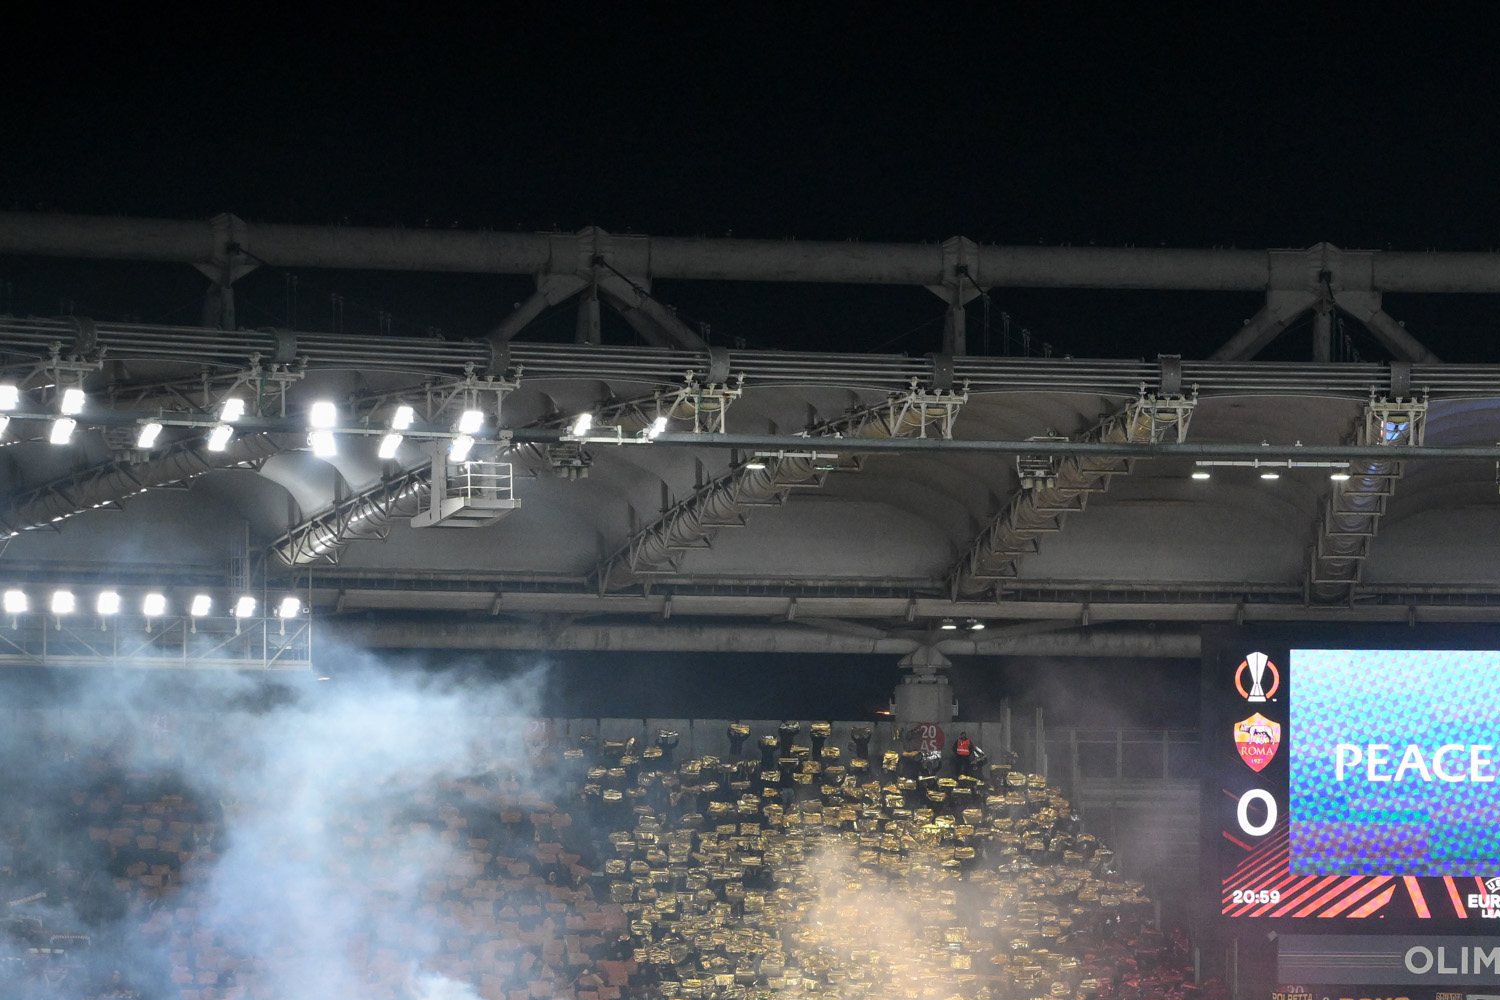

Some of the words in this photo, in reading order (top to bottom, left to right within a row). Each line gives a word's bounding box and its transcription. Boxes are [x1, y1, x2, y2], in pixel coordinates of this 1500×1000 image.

[920, 725, 937, 739] 20
[1241, 746, 1274, 756] ROMA
[1335, 743, 1496, 783] PEACE
[1236, 788, 1278, 837] 0
[1232, 889, 1281, 904] 20:59
